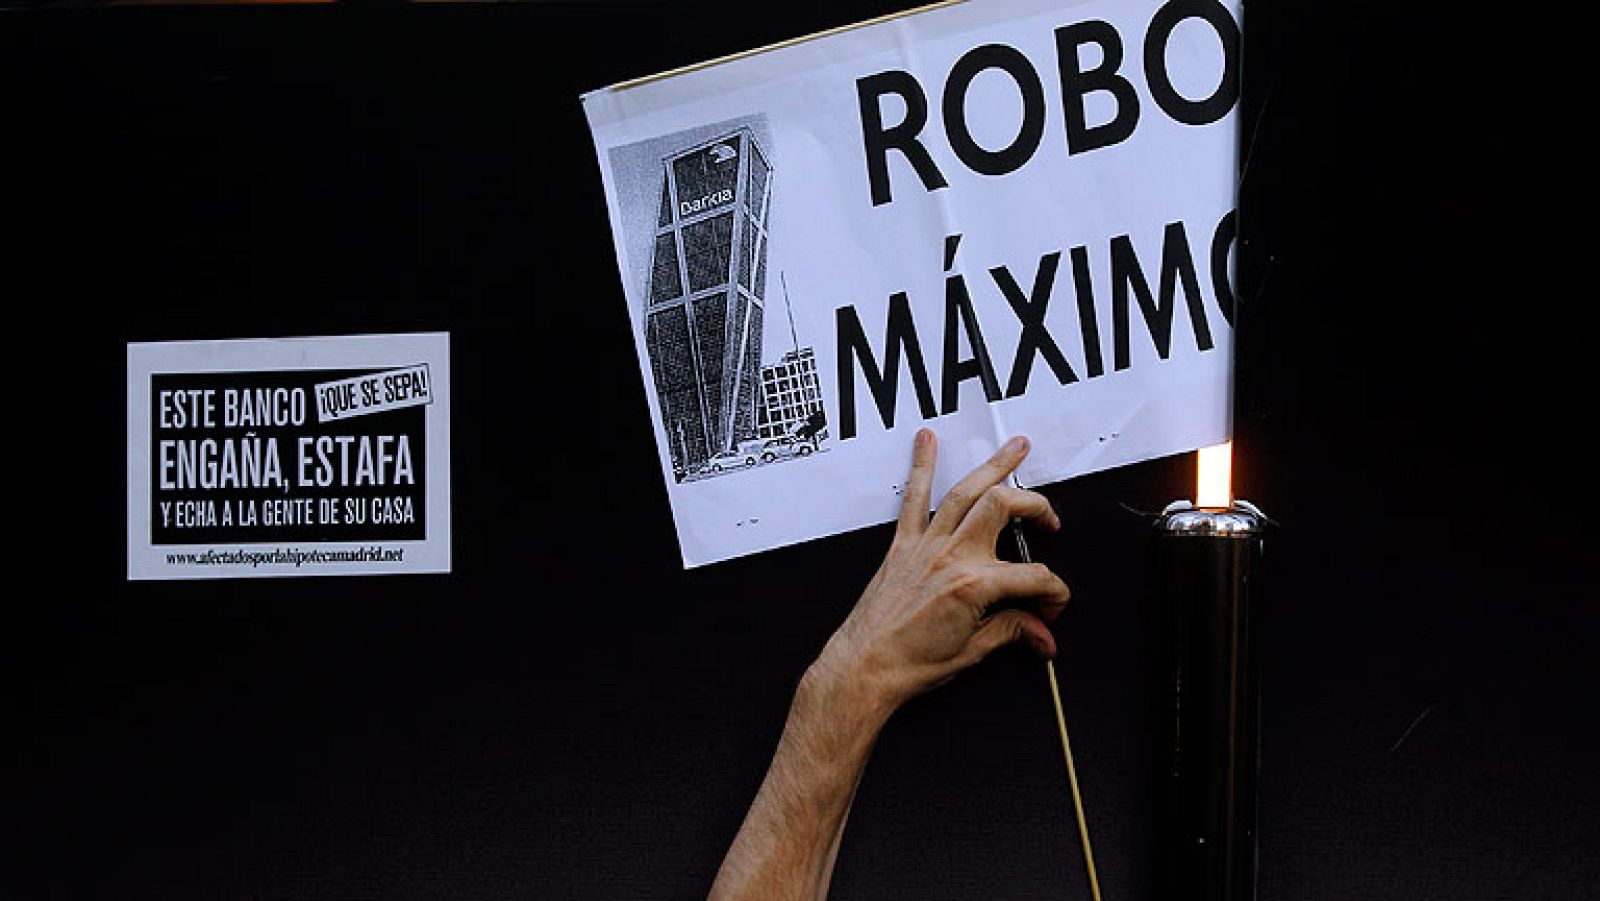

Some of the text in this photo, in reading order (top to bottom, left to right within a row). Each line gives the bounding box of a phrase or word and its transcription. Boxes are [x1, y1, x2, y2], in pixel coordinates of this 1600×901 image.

[856, 0, 1240, 207] ROBO
[159, 387, 306, 429] ESTE BANCO
[320, 370, 428, 418] ¡QUE SE SEPA!
[159, 431, 416, 493] ENGAÑA, ESTAFA
[160, 496, 416, 529] Y ECHA A LA GENTE DE SU CASA
[166, 545, 405, 568] www.afectadosporlahipotecamadrid.net
